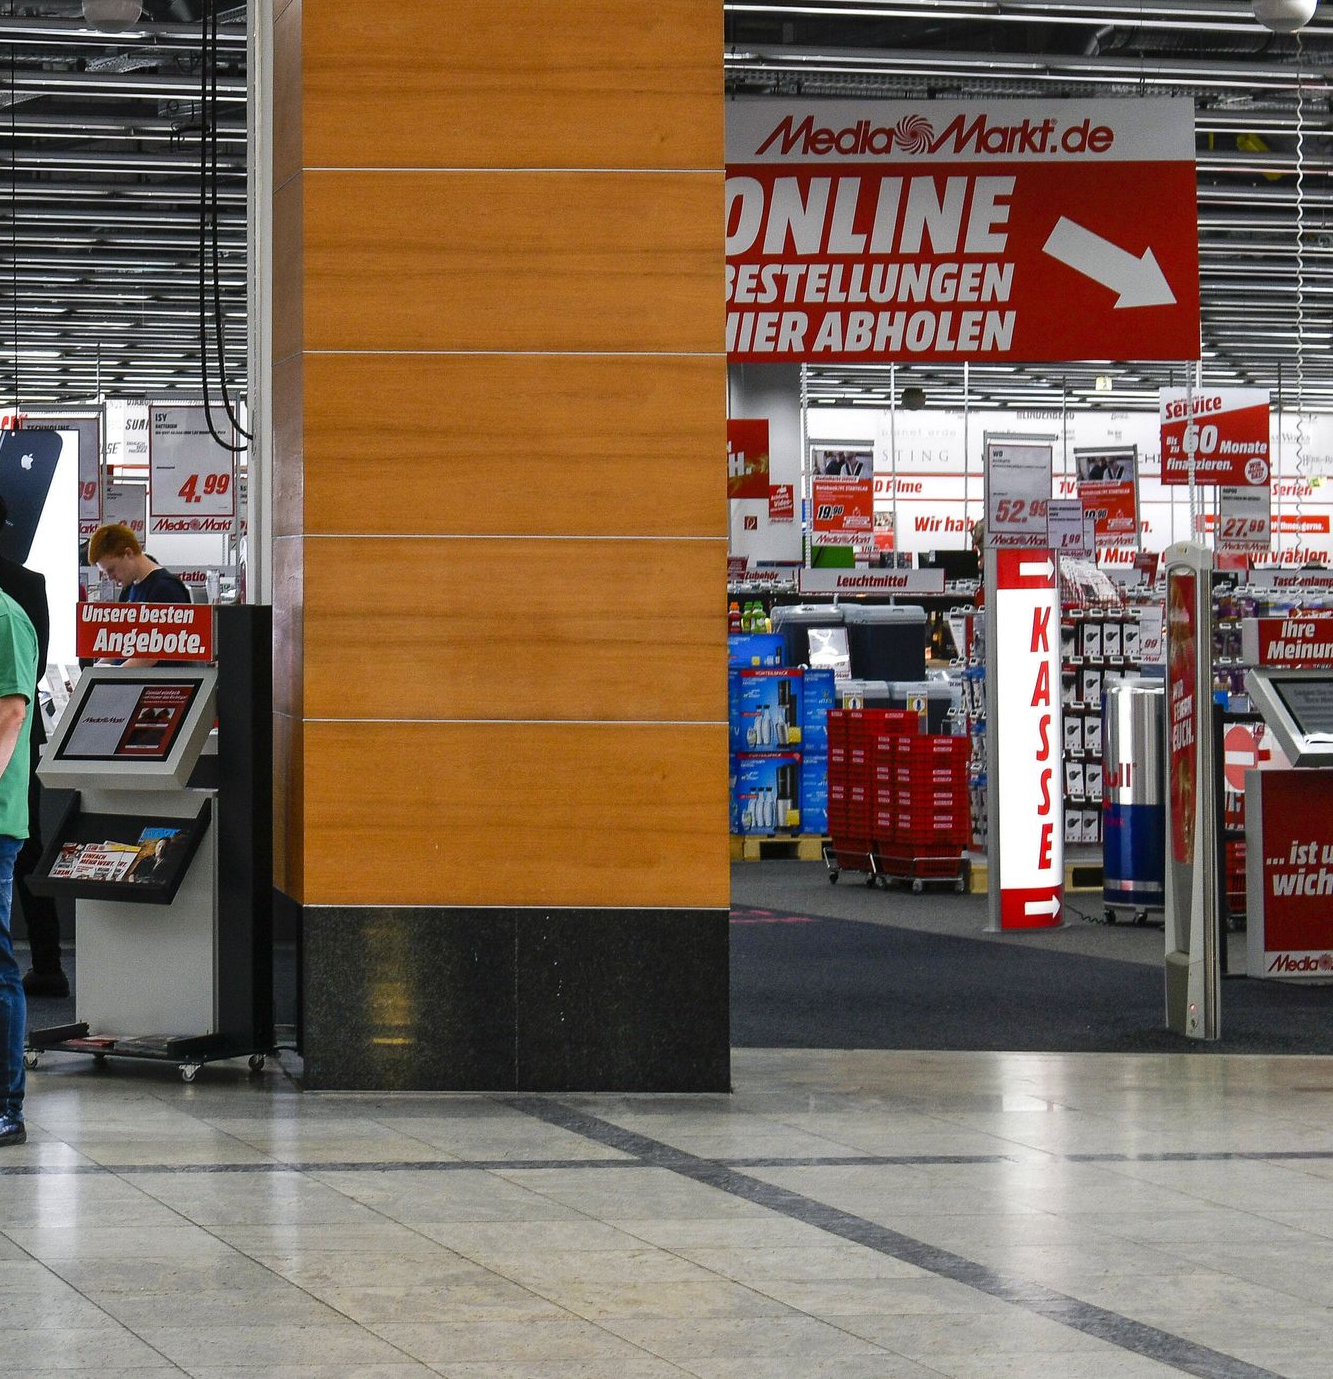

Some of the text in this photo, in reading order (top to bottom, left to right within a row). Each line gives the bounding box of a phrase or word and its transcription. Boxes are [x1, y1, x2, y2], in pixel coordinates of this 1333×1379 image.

[754, 115, 896, 155] Media
[725, 175, 1017, 256] ONLINE
[814, 309, 1017, 352] ABHOLEN
[155, 413, 167, 423] ISY
[1166, 436, 1178, 446] Bis
[1183, 424, 1219, 454] 60
[1219, 440, 1267, 454] Monate
[1169, 445, 1180, 453] zu
[178, 473, 230, 503] 4.99
[1272, 483, 1313, 496] Serien
[773, 499, 791, 508] Video-
[995, 499, 1047, 524] 52.99
[152, 518, 231, 531] Media Markt
[1223, 518, 1265, 538] 27.99
[836, 575, 909, 588] Leuchtmittel
[82, 605, 194, 624] Unsere besten
[1282, 621, 1315, 638] Ihre
[93, 628, 206, 657] Angebote.
[1030, 606, 1054, 869] KASSE
[1290, 840, 1318, 865] ist
[1268, 954, 1319, 972] Media
